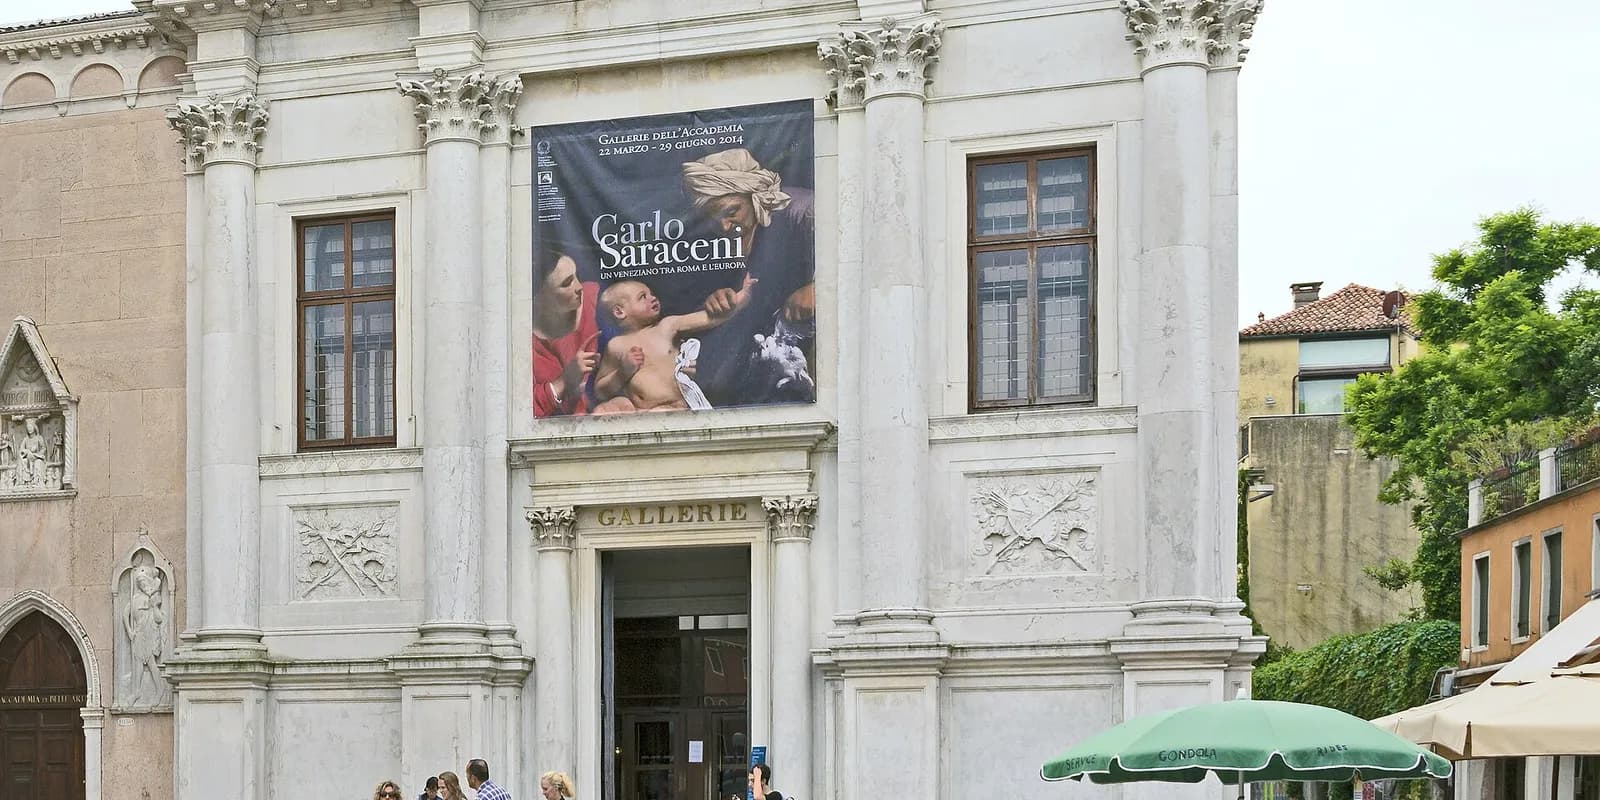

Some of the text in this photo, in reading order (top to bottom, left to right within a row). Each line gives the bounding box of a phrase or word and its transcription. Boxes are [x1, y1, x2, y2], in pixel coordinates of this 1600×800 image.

[598, 133, 650, 145] GALLERIE
[599, 148, 611, 156] 22
[613, 144, 649, 155] MARZO
[659, 142, 672, 152] 29
[675, 137, 716, 149] GIUGNO
[719, 135, 745, 145] 2014
[591, 209, 685, 247] Carlo
[600, 226, 745, 270] Saraceni
[600, 271, 613, 280] UN
[613, 267, 659, 279] VENEZIANO
[658, 266, 676, 275] TRA
[676, 264, 701, 274] ROMA
[709, 261, 746, 271] L'EUROPA
[598, 502, 748, 527] GALLERIE
[1158, 747, 1217, 762] GONDOLA
[1316, 744, 1348, 757] RIDES
